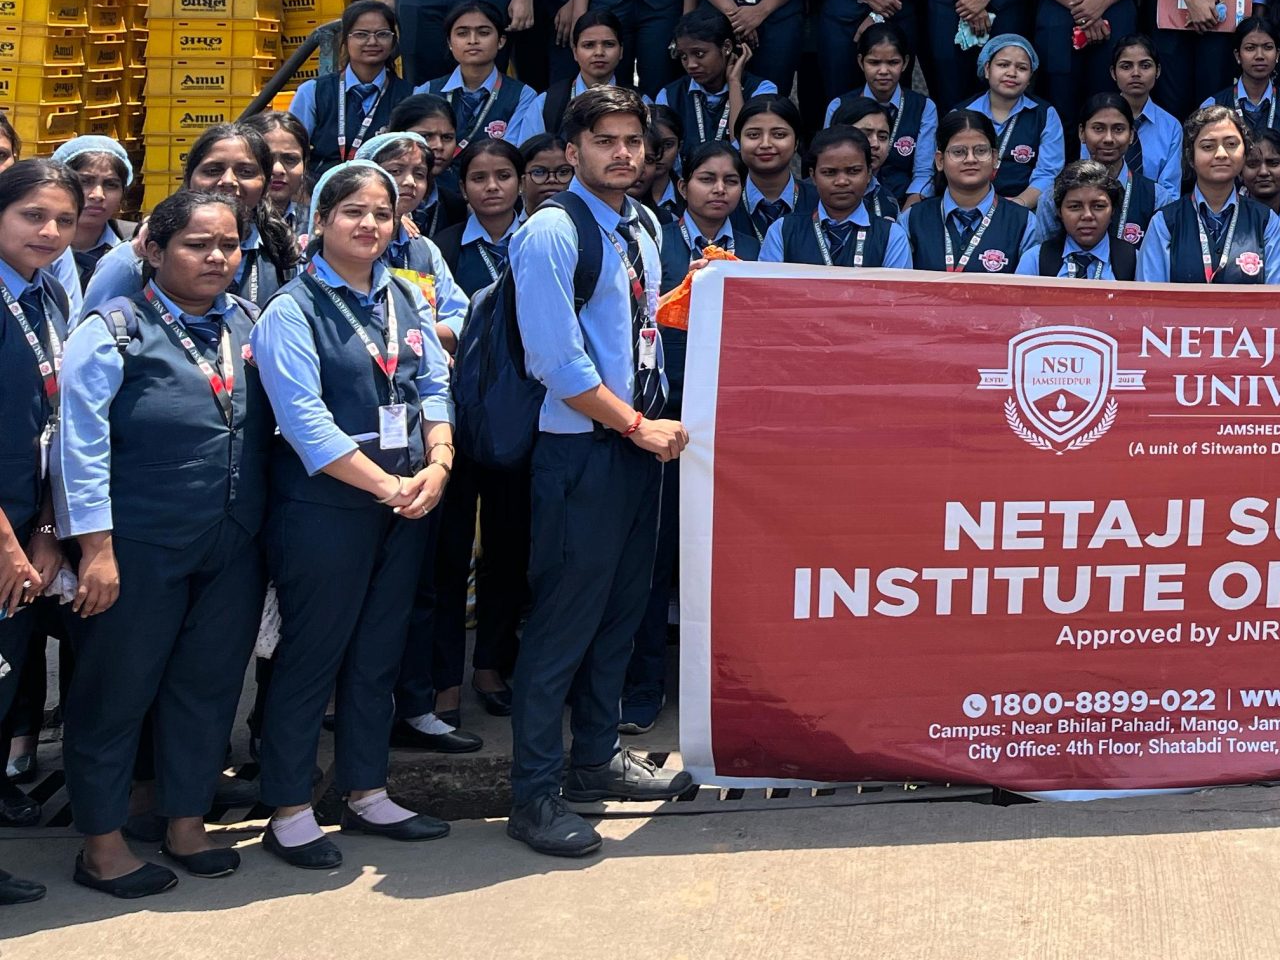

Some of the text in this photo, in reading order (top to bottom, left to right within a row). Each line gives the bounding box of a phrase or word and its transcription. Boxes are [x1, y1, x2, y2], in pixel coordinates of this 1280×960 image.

[180, 36, 222, 47] अमूल
[181, 74, 225, 85] Amul
[180, 112, 224, 123] Amul
[152, 299, 166, 314] NSU
[17, 314, 33, 332] NSU
[170, 322, 186, 338] NSU
[33, 344, 47, 362] NSU
[190, 347, 204, 363] NSU
[1040, 356, 1085, 374] NSU
[1032, 376, 1092, 387] JAMSHEDPUR
[1128, 441, 1145, 457] (A
[1149, 441, 1178, 455] unit
[1183, 441, 1198, 455] of
[1202, 441, 1267, 455] Sitwanto
[945, 499, 1205, 551] NETAJI
[794, 564, 1186, 620] INSTITUTE
[1055, 624, 1181, 647] Approved
[1190, 623, 1220, 646] by
[990, 689, 1216, 716] 1800-8899-022
[928, 722, 1006, 740] Campus:
[1011, 720, 1053, 735] Near
[1057, 717, 1107, 733] Bhilai
[1111, 716, 1175, 734] Pahadi,
[1180, 716, 1244, 733] Mango,
[968, 743, 1001, 762] City
[1006, 741, 1061, 758] Office:
[1066, 739, 1094, 756] 4th
[1098, 738, 1144, 758] Floor,
[1148, 737, 1222, 755] Shatabdi
[1226, 737, 1280, 756] Tower,
